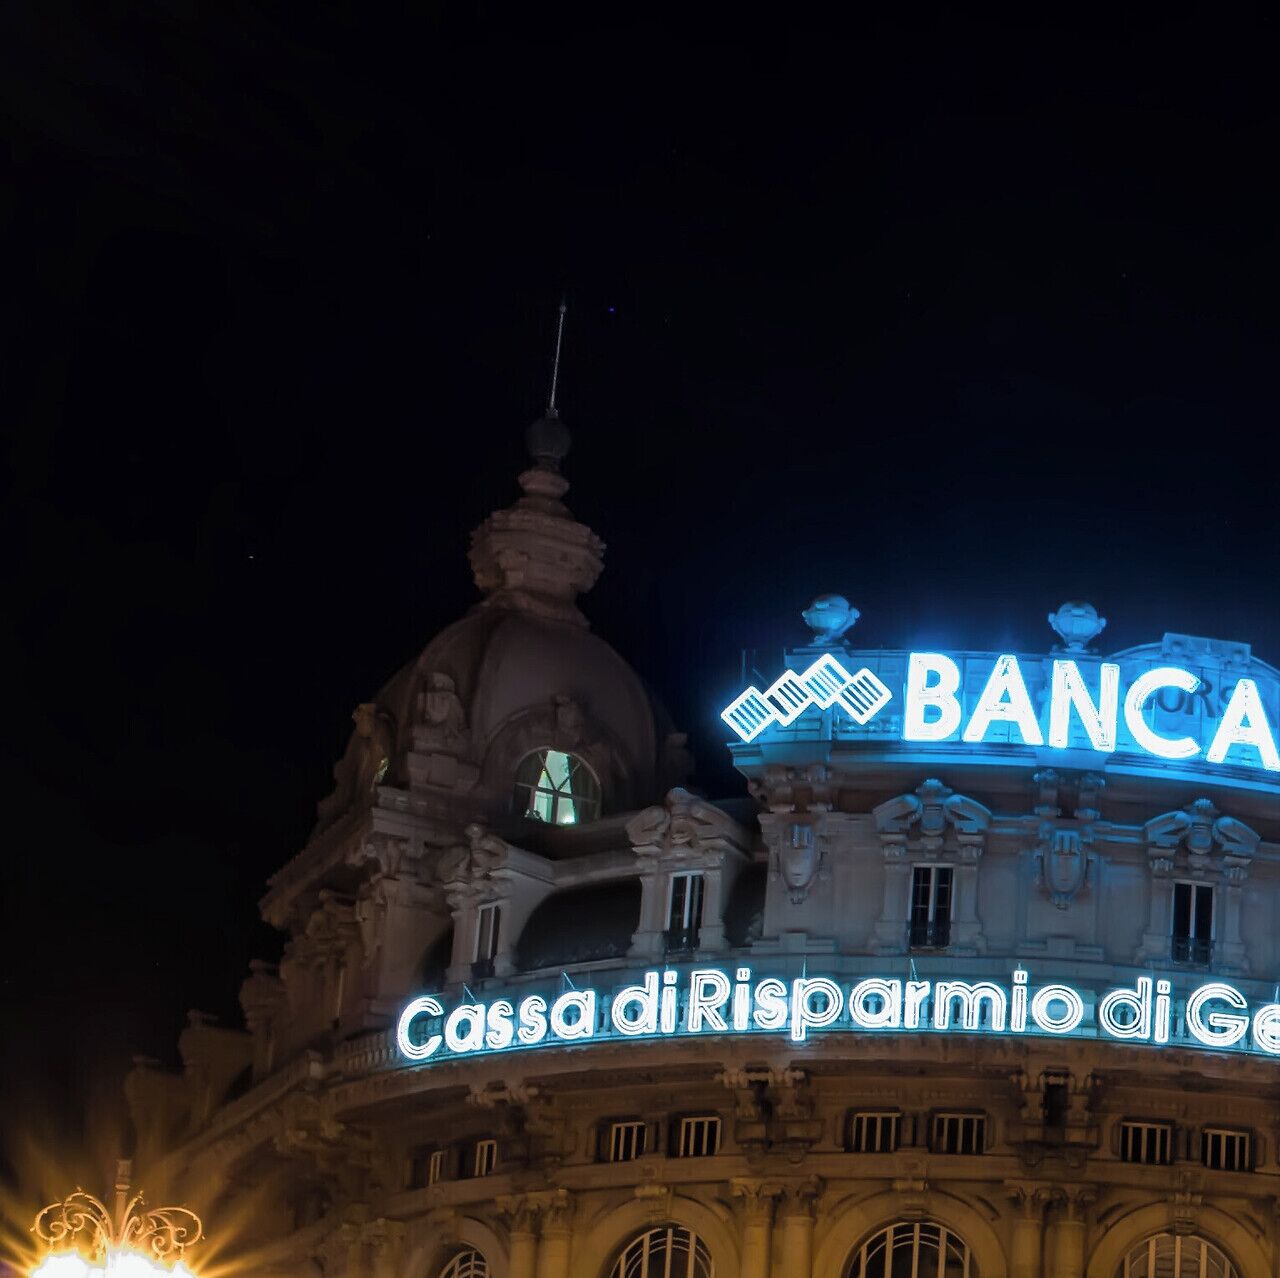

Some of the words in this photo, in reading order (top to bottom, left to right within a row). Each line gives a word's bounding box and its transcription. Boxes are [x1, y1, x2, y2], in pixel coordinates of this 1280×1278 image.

[397, 989, 596, 1060] Cassa
[611, 971, 677, 1036] di
[687, 968, 1084, 1042] Risparmio
[1099, 976, 1171, 1043] di
